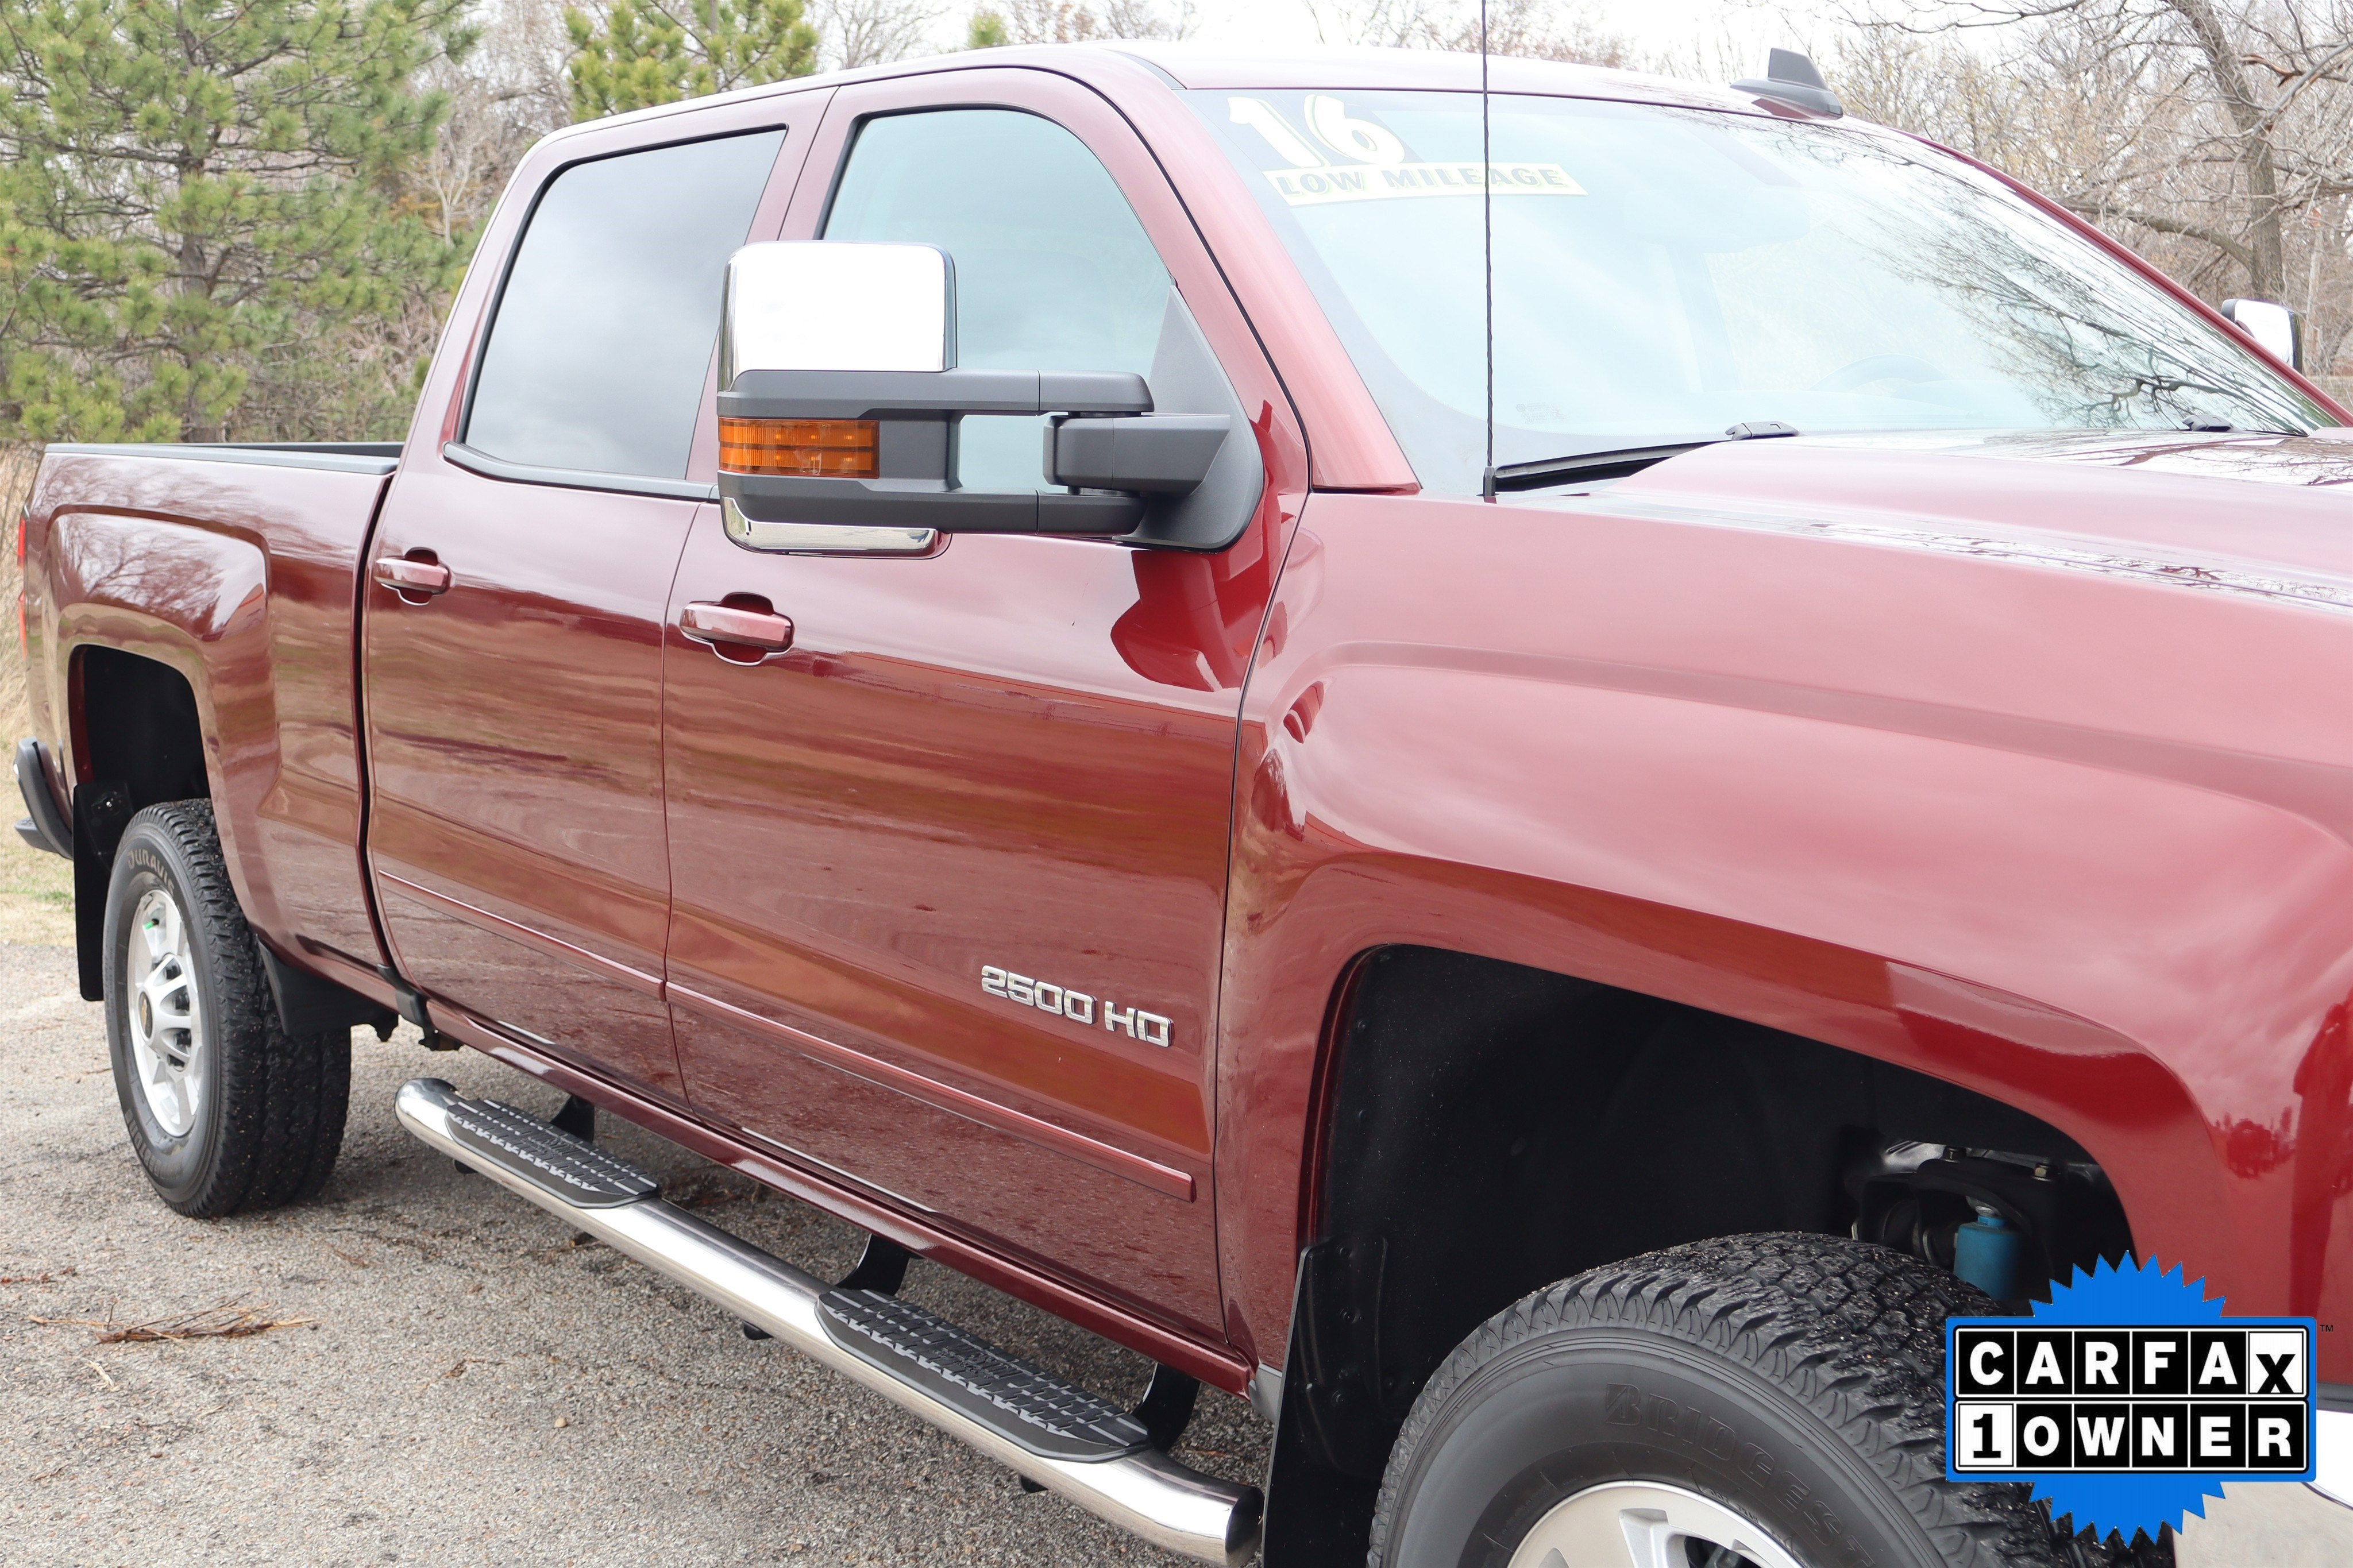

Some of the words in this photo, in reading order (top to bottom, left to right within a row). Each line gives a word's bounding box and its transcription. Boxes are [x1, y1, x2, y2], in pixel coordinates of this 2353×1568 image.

[1227, 94, 1405, 168] 16
[1276, 171, 1364, 195] LOW
[1387, 168, 1567, 188] MILEAGE
[981, 965, 1097, 1024] 2500
[1105, 1001, 1173, 1048] HD
